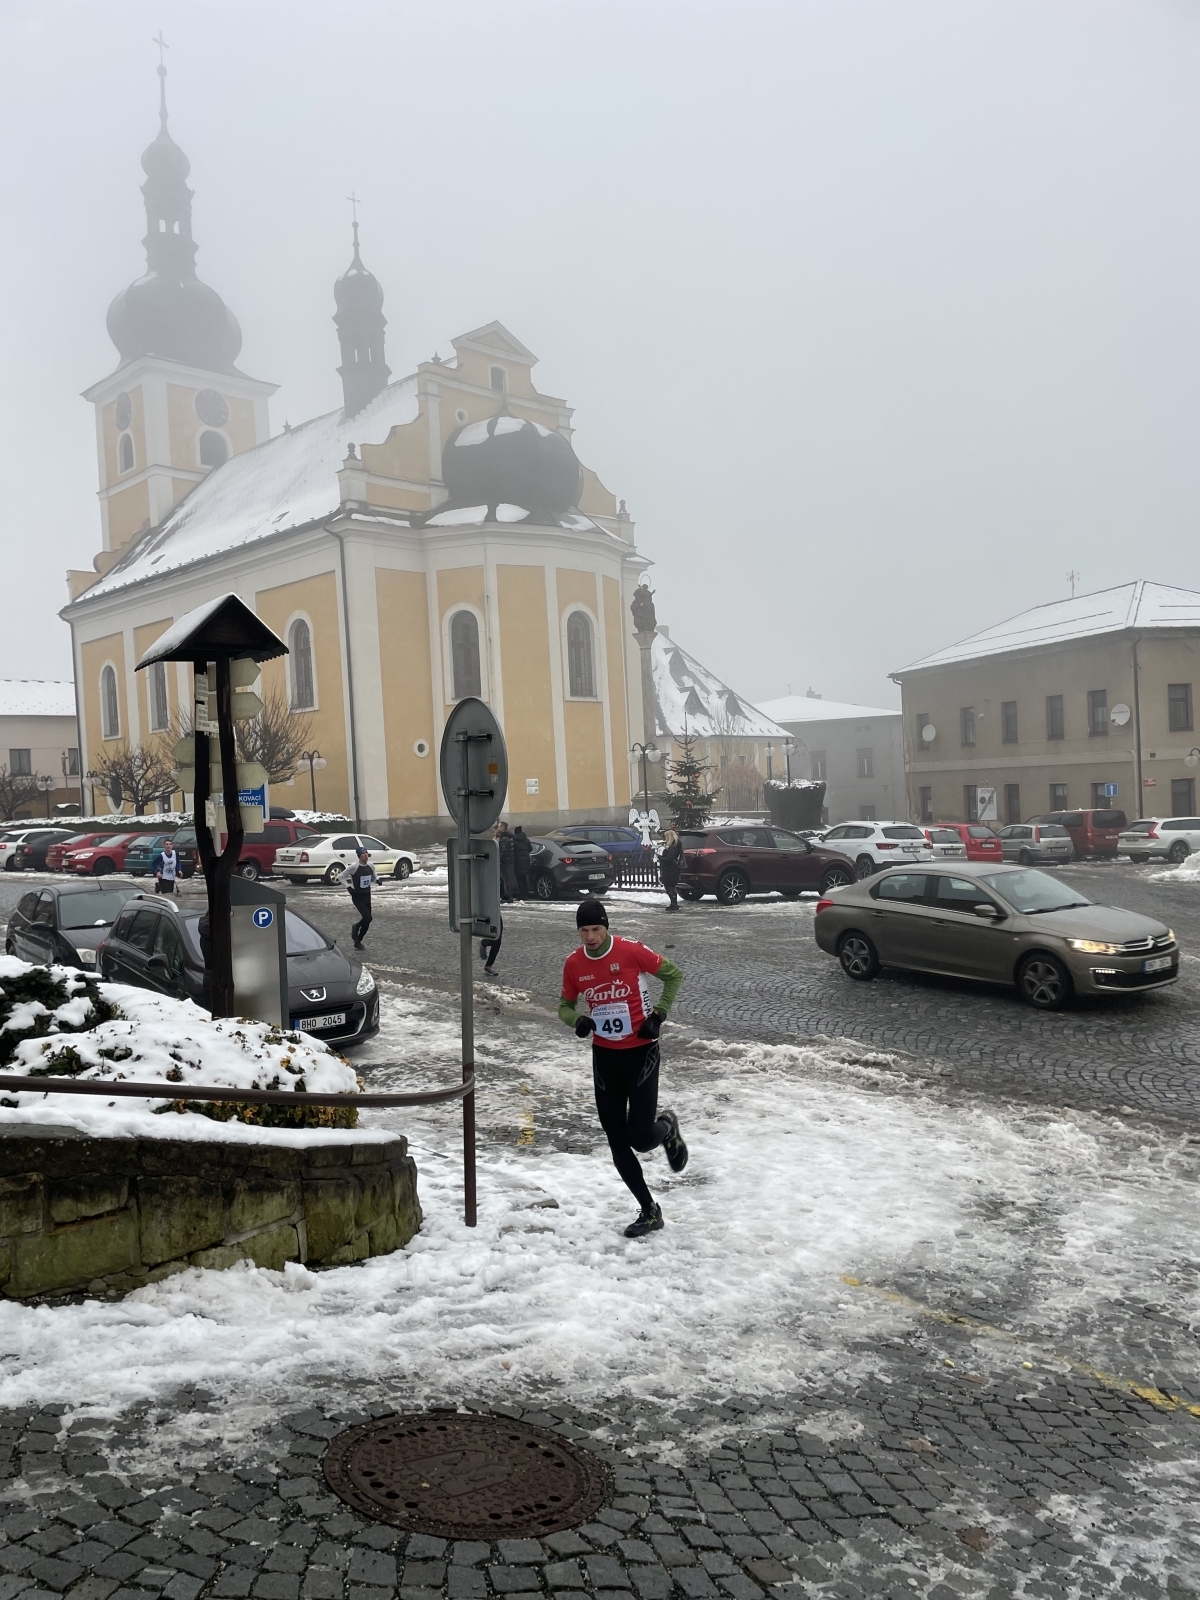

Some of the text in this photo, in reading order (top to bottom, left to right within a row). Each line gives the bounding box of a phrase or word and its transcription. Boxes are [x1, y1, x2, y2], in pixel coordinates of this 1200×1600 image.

[258, 911, 269, 925] P
[584, 984, 630, 1001] Carla
[322, 1014, 342, 1027] 2045
[602, 1018, 624, 1034] 49
